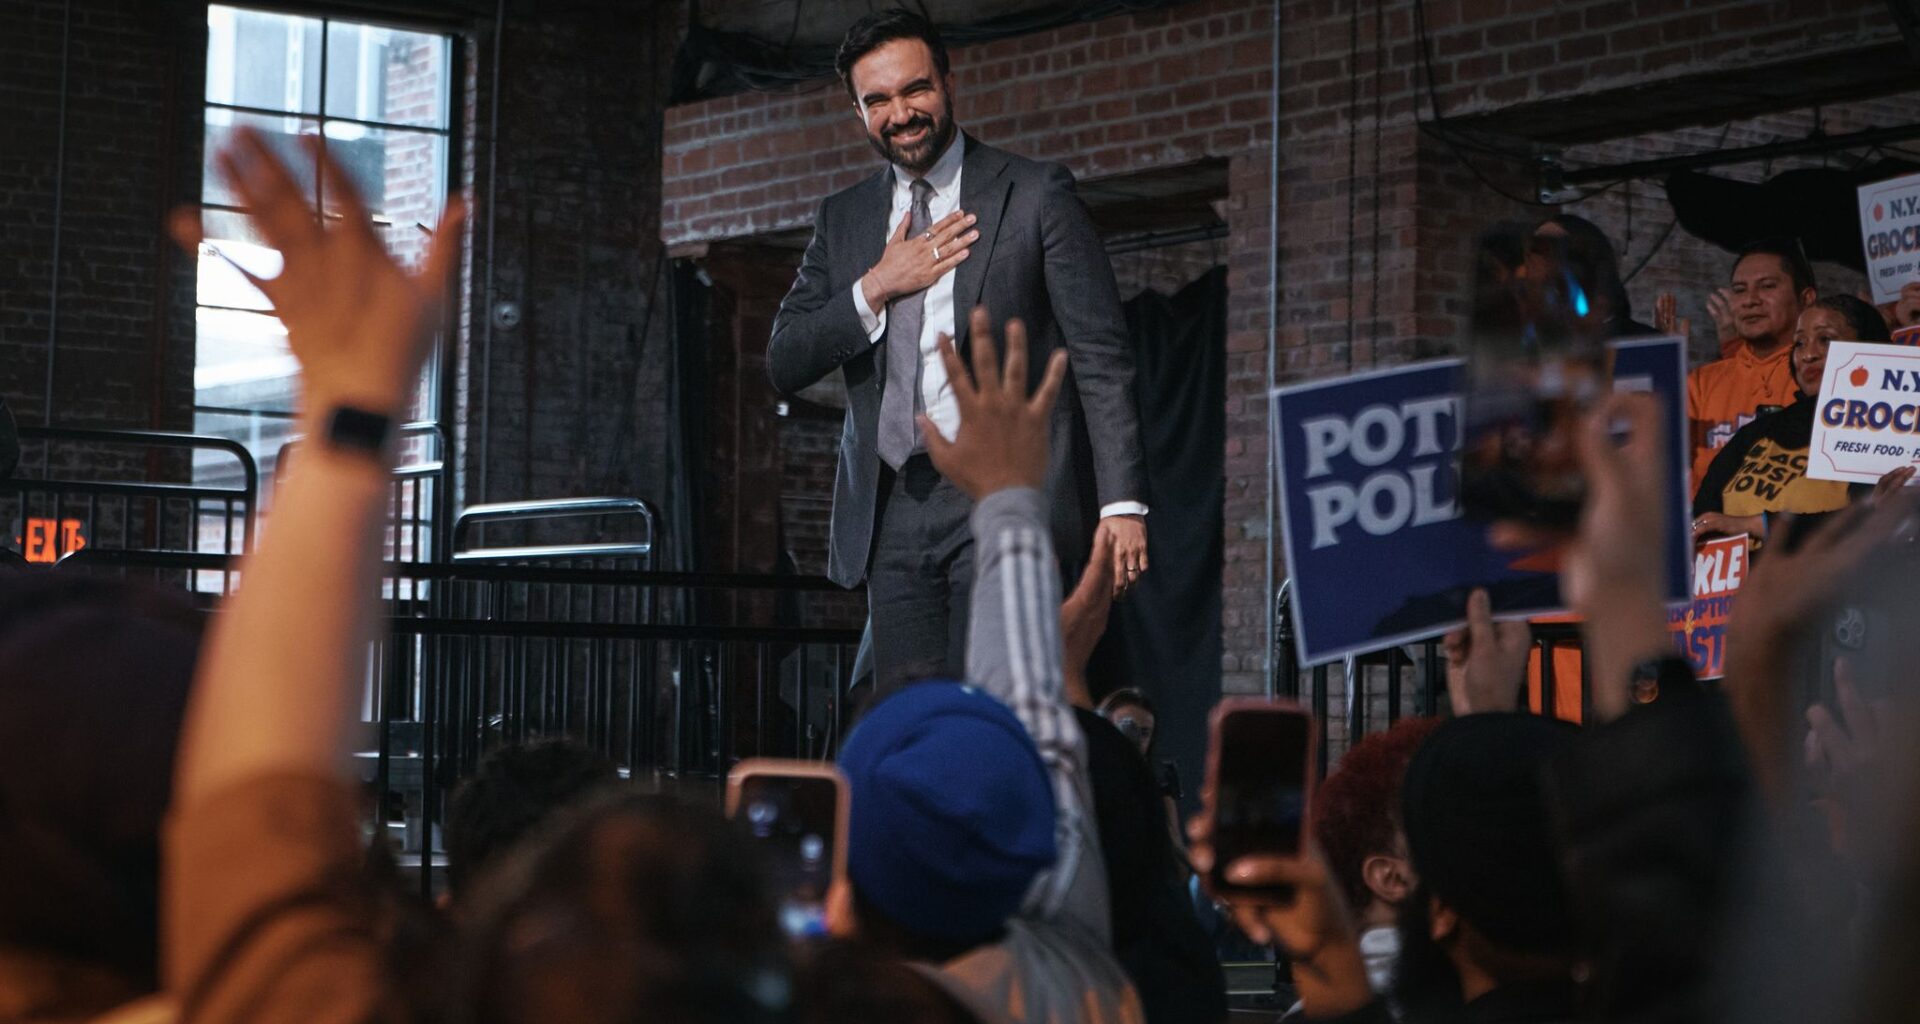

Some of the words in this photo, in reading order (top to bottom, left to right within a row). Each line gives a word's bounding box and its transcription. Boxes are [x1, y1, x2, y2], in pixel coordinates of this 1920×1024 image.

[1834, 441, 1870, 454] FRESH
[1873, 445, 1904, 456] FOOD
[1728, 475, 1783, 501] OW
[1305, 464, 1463, 550] POL
